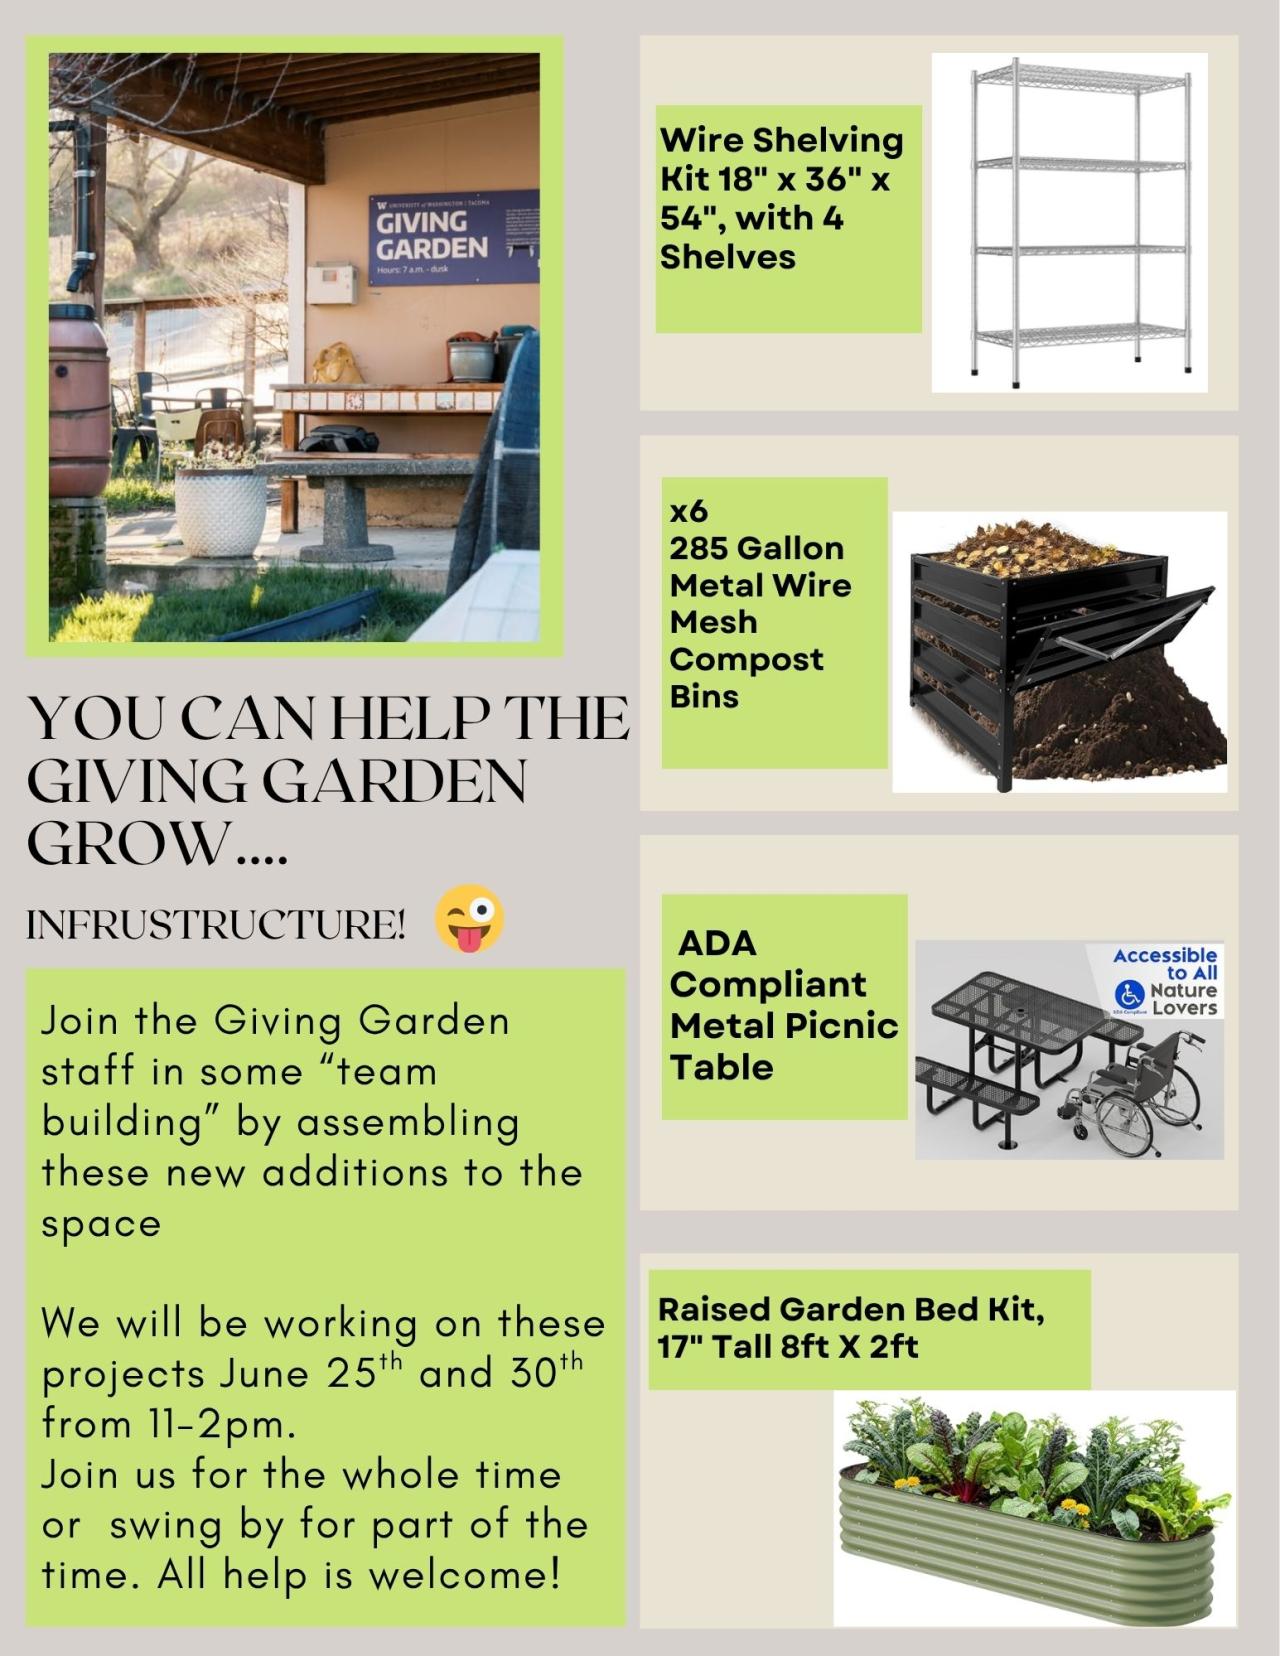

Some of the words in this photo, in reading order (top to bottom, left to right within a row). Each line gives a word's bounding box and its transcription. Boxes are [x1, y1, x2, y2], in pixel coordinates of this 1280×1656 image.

[659, 124, 744, 153] Wire
[753, 124, 903, 160] Shelving
[661, 163, 710, 192] Kit
[718, 166, 767, 192] 18"
[777, 172, 796, 192] x
[805, 166, 862, 192] 36"
[871, 172, 890, 192] x
[376, 210, 468, 234] GIVING
[661, 205, 727, 236] 54",
[735, 202, 813, 231] with
[822, 205, 844, 231] 4
[376, 236, 489, 261] GARDEN
[660, 242, 796, 270] Shelves
[377, 266, 401, 274] Hours:
[402, 265, 408, 273] 7
[430, 264, 449, 273] dusk
[669, 498, 709, 523] x6
[670, 535, 728, 561] 285
[737, 534, 844, 561] Gallon
[671, 572, 763, 598] Metal
[772, 570, 852, 598] Wire
[671, 608, 757, 634] Mesh
[669, 646, 824, 678] Compost
[671, 681, 739, 709] Bins
[27, 695, 165, 741] YOU
[180, 694, 315, 741] CAN
[330, 695, 491, 741] HELP
[504, 695, 631, 741] THE
[27, 758, 248, 804] GIVING
[262, 757, 527, 804] GARDEN
[27, 820, 288, 866] GROW....
[26, 908, 406, 940] INFRUSTRUCTURE!
[677, 929, 757, 956] ADA
[1113, 946, 1218, 963] Accessible
[670, 967, 867, 1005] Compliant
[1167, 966, 1188, 981] to
[1192, 964, 1218, 981] All
[1151, 983, 1218, 998] Nature
[40, 1004, 117, 1035] Join
[134, 1001, 197, 1035] the
[214, 1003, 340, 1046] Giving
[359, 1001, 508, 1035] Garden
[671, 1011, 774, 1039] Metal
[786, 1009, 899, 1039] Picnic
[1153, 1000, 1218, 1016] Lovers
[42, 1051, 134, 1086] staff
[153, 1058, 183, 1085] in
[200, 1064, 303, 1086] some
[669, 1052, 774, 1081] Table
[238, 1102, 281, 1147] by
[297, 1102, 518, 1147] assembling
[41, 1152, 149, 1187] these
[167, 1165, 246, 1188] new
[262, 1152, 448, 1187] additions
[464, 1158, 503, 1187] to
[519, 1152, 582, 1187] the
[41, 1216, 161, 1248] space
[41, 1306, 100, 1339] We
[116, 1303, 180, 1339] will
[200, 1303, 247, 1338] be
[263, 1303, 416, 1348] working
[435, 1316, 480, 1337] on
[497, 1303, 605, 1338] these
[659, 1294, 770, 1322] Raised
[780, 1295, 905, 1322] Garden
[915, 1295, 978, 1322] Bed
[989, 1294, 1045, 1326] Kit,
[657, 1334, 703, 1359] 17"
[711, 1333, 771, 1359] Tall
[781, 1332, 830, 1359] 8ft
[838, 1334, 861, 1359] X
[870, 1332, 919, 1359] 2ft
[43, 1360, 204, 1399] projects
[219, 1357, 308, 1388] June
[420, 1354, 491, 1388] and
[42, 1404, 130, 1439] from
[40, 1458, 117, 1489] Join
[136, 1468, 175, 1489] us
[192, 1455, 248, 1489] for
[263, 1455, 325, 1489] the
[342, 1455, 459, 1490] whole
[475, 1461, 561, 1489] time
[42, 1517, 81, 1539] or
[110, 1511, 221, 1549] swing
[241, 1504, 284, 1549] by
[300, 1504, 355, 1539] for
[373, 1510, 453, 1549] part
[470, 1504, 509, 1539] of
[525, 1504, 588, 1539] the
[41, 1561, 139, 1590] time.
[157, 1555, 204, 1589] All
[224, 1555, 307, 1600] help
[325, 1561, 352, 1590] is
[368, 1555, 559, 1590] welcome!
